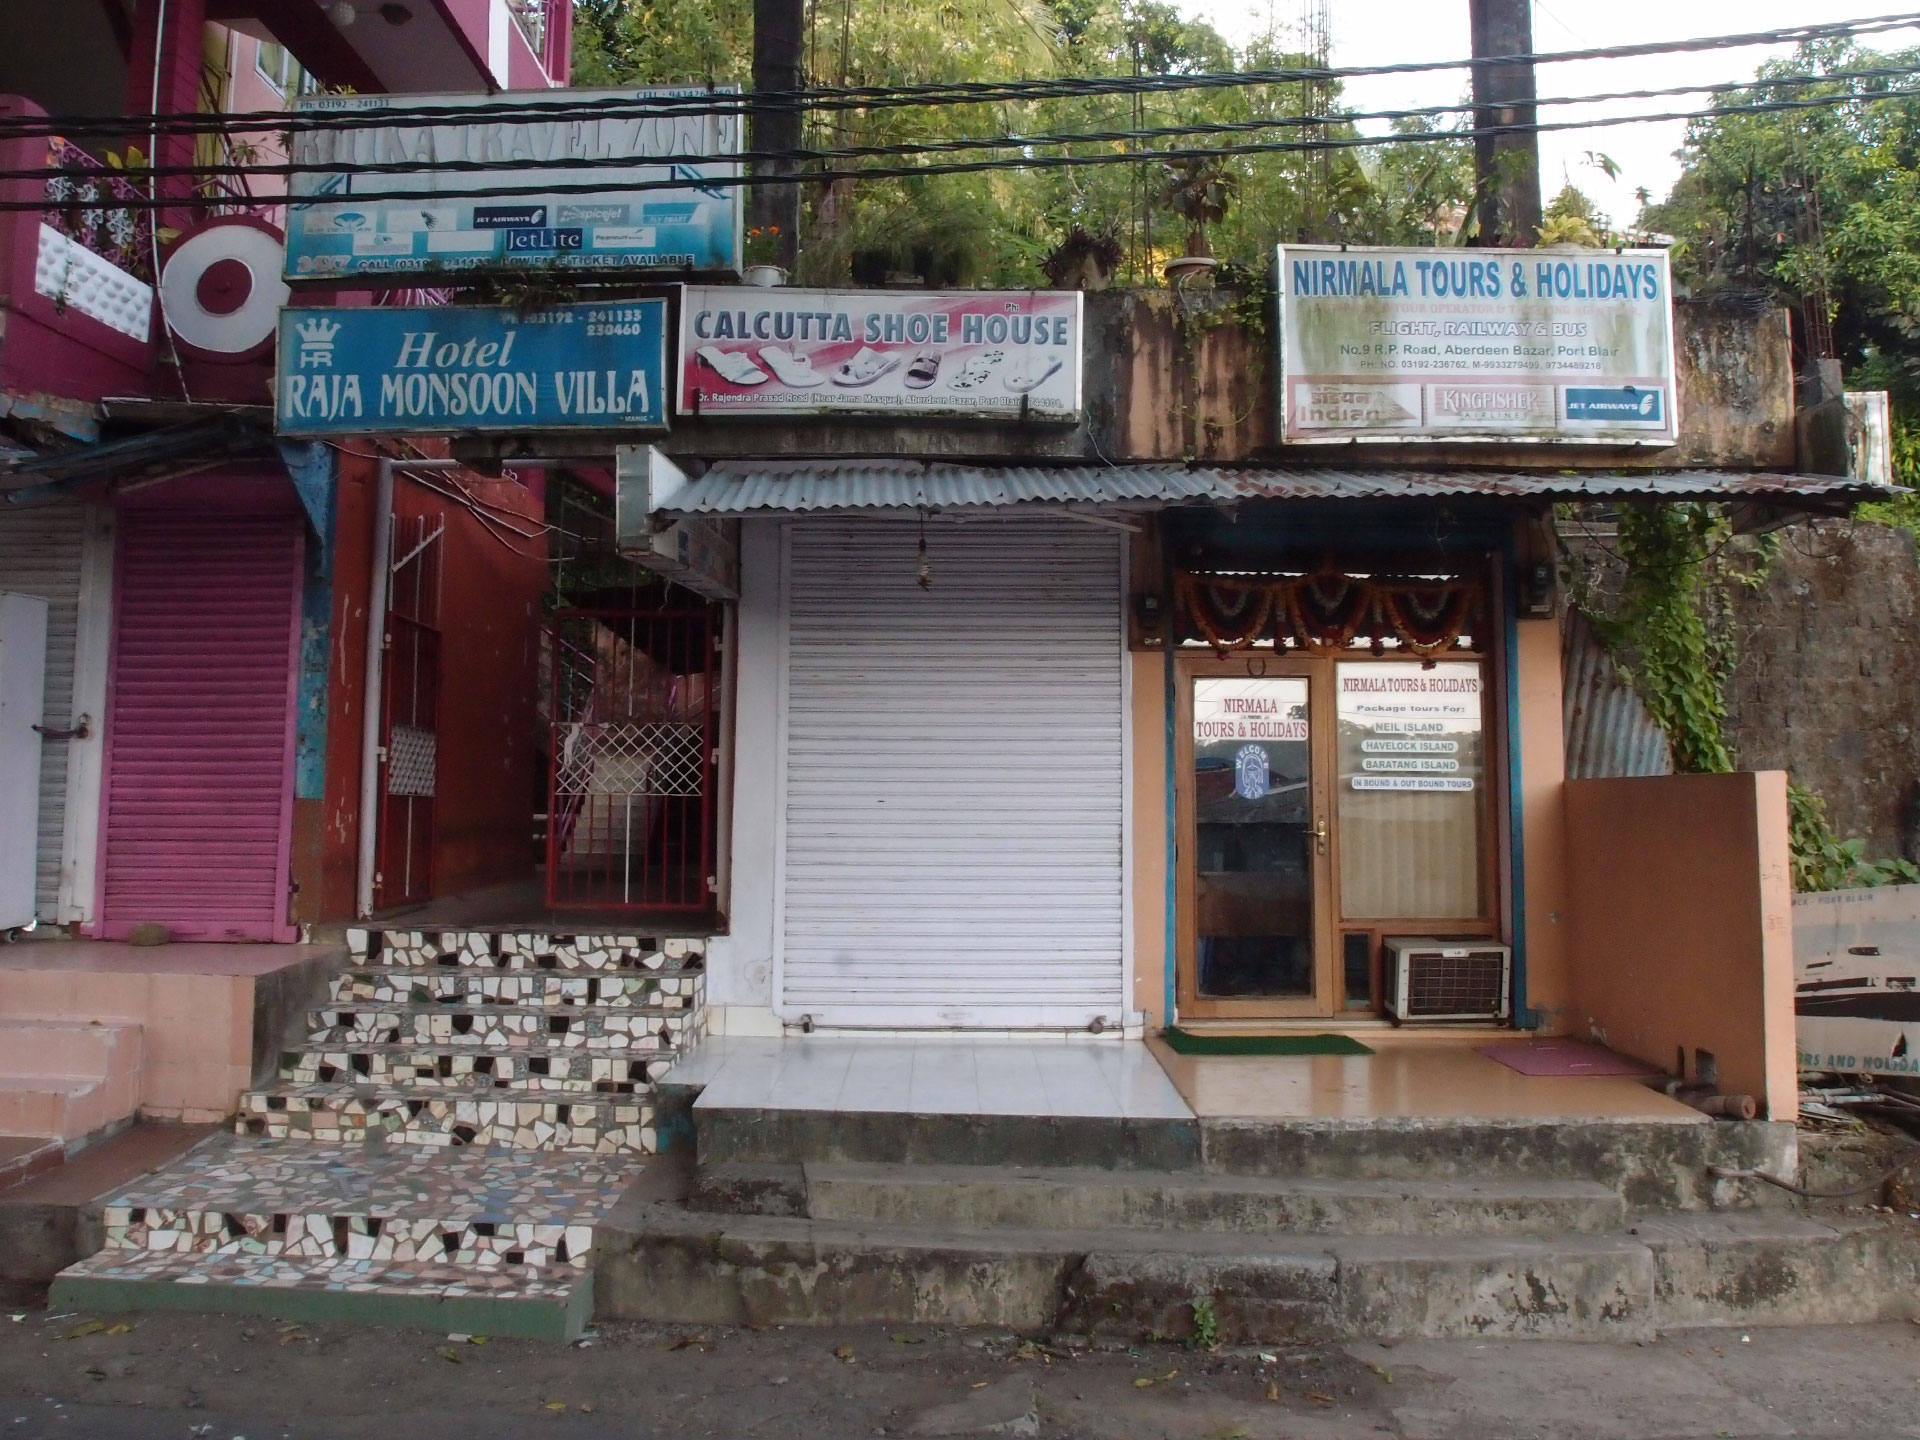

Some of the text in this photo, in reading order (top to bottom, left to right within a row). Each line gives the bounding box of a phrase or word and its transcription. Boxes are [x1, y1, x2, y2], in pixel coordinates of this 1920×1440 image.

[300, 101, 315, 109] Ph:
[318, 100, 347, 109] 03192
[357, 99, 390, 108] 241133
[509, 230, 580, 250] JetLite
[358, 259, 391, 271] CALL
[534, 256, 566, 267] FAE
[570, 255, 619, 267] TICKET
[622, 253, 695, 266] AVAILABLE
[1292, 260, 1658, 300] NIRMALA TOURS & HOLIDAYS
[588, 310, 642, 322] 241133
[586, 324, 641, 336] 230460
[694, 310, 1068, 345] CALCUTTA SHOE HOUSE
[1369, 321, 1587, 338] FLIGHT, RAILWAY & BUS
[394, 331, 516, 368] Hotel
[1341, 344, 1619, 357] No.9 R.P. Road, Aberdeen Bazar, Port Blair
[1360, 360, 1378, 369] PH:
[1381, 360, 1398, 369] NO.
[285, 370, 650, 421] RAJA MONSOON VILLA
[712, 392, 750, 404] Rajendra
[753, 393, 783, 402] Prasad
[786, 393, 808, 402] Road
[811, 393, 835, 404] (Near
[905, 395, 947, 405] Aberdeen
[979, 396, 998, 406] Port
[1443, 389, 1538, 412] KINGFISHER
[1568, 402, 1639, 410] JET AIRWAYS
[1301, 406, 1379, 422] Indian
[1464, 410, 1529, 420] AIRLINES
[1343, 677, 1478, 693] NIRMALA TOURS & HOLIDAYS
[1223, 699, 1278, 713] NIRMALA
[1356, 705, 1407, 713] Package
[1443, 705, 1466, 713] For:
[1195, 721, 1307, 739] TOURS & HOLIDAYS
[1375, 722, 1444, 732] NEIL ISLAND
[1366, 741, 1455, 751] HAVELOCK ISLAND
[1235, 745, 1270, 770] WELCOME
[1365, 760, 1456, 770] BARATANG ISLAND
[1353, 779, 1362, 787] IN
[1363, 779, 1390, 787] BOUND
[1417, 780, 1445, 788] BOUND
[1446, 780, 1472, 788] TOURS
[1827, 1054, 1856, 1068] AND
